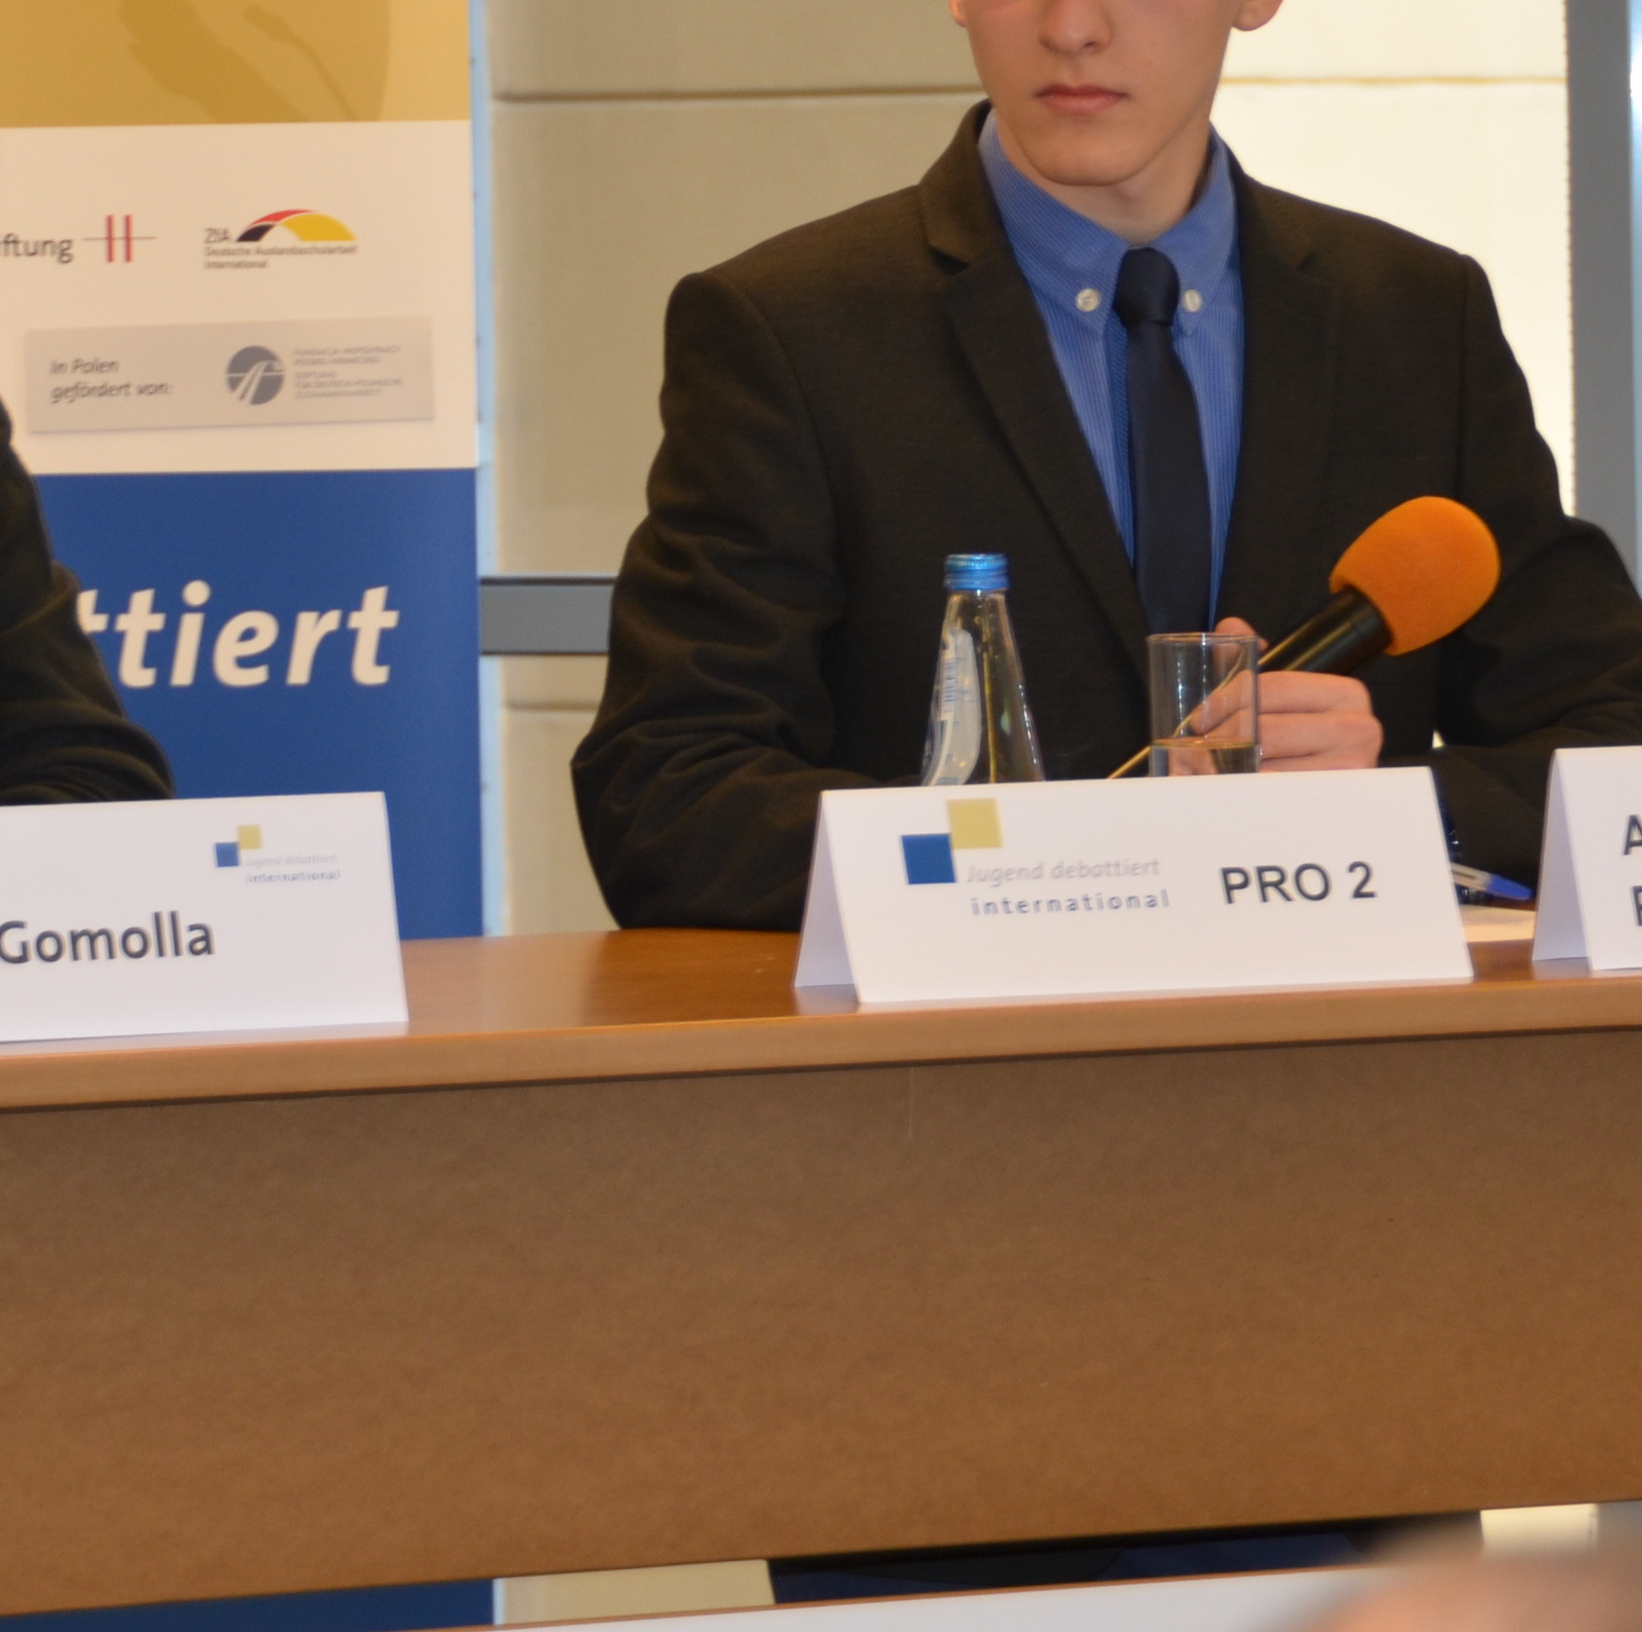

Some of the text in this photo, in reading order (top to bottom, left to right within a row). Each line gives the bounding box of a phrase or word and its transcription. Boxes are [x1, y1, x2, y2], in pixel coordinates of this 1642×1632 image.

[71, 356, 119, 374] Polen
[50, 381, 132, 404] gefördert
[965, 858, 1161, 887] Jugend debattiert
[1221, 862, 1377, 905] PRO 2
[971, 889, 1170, 917] international
